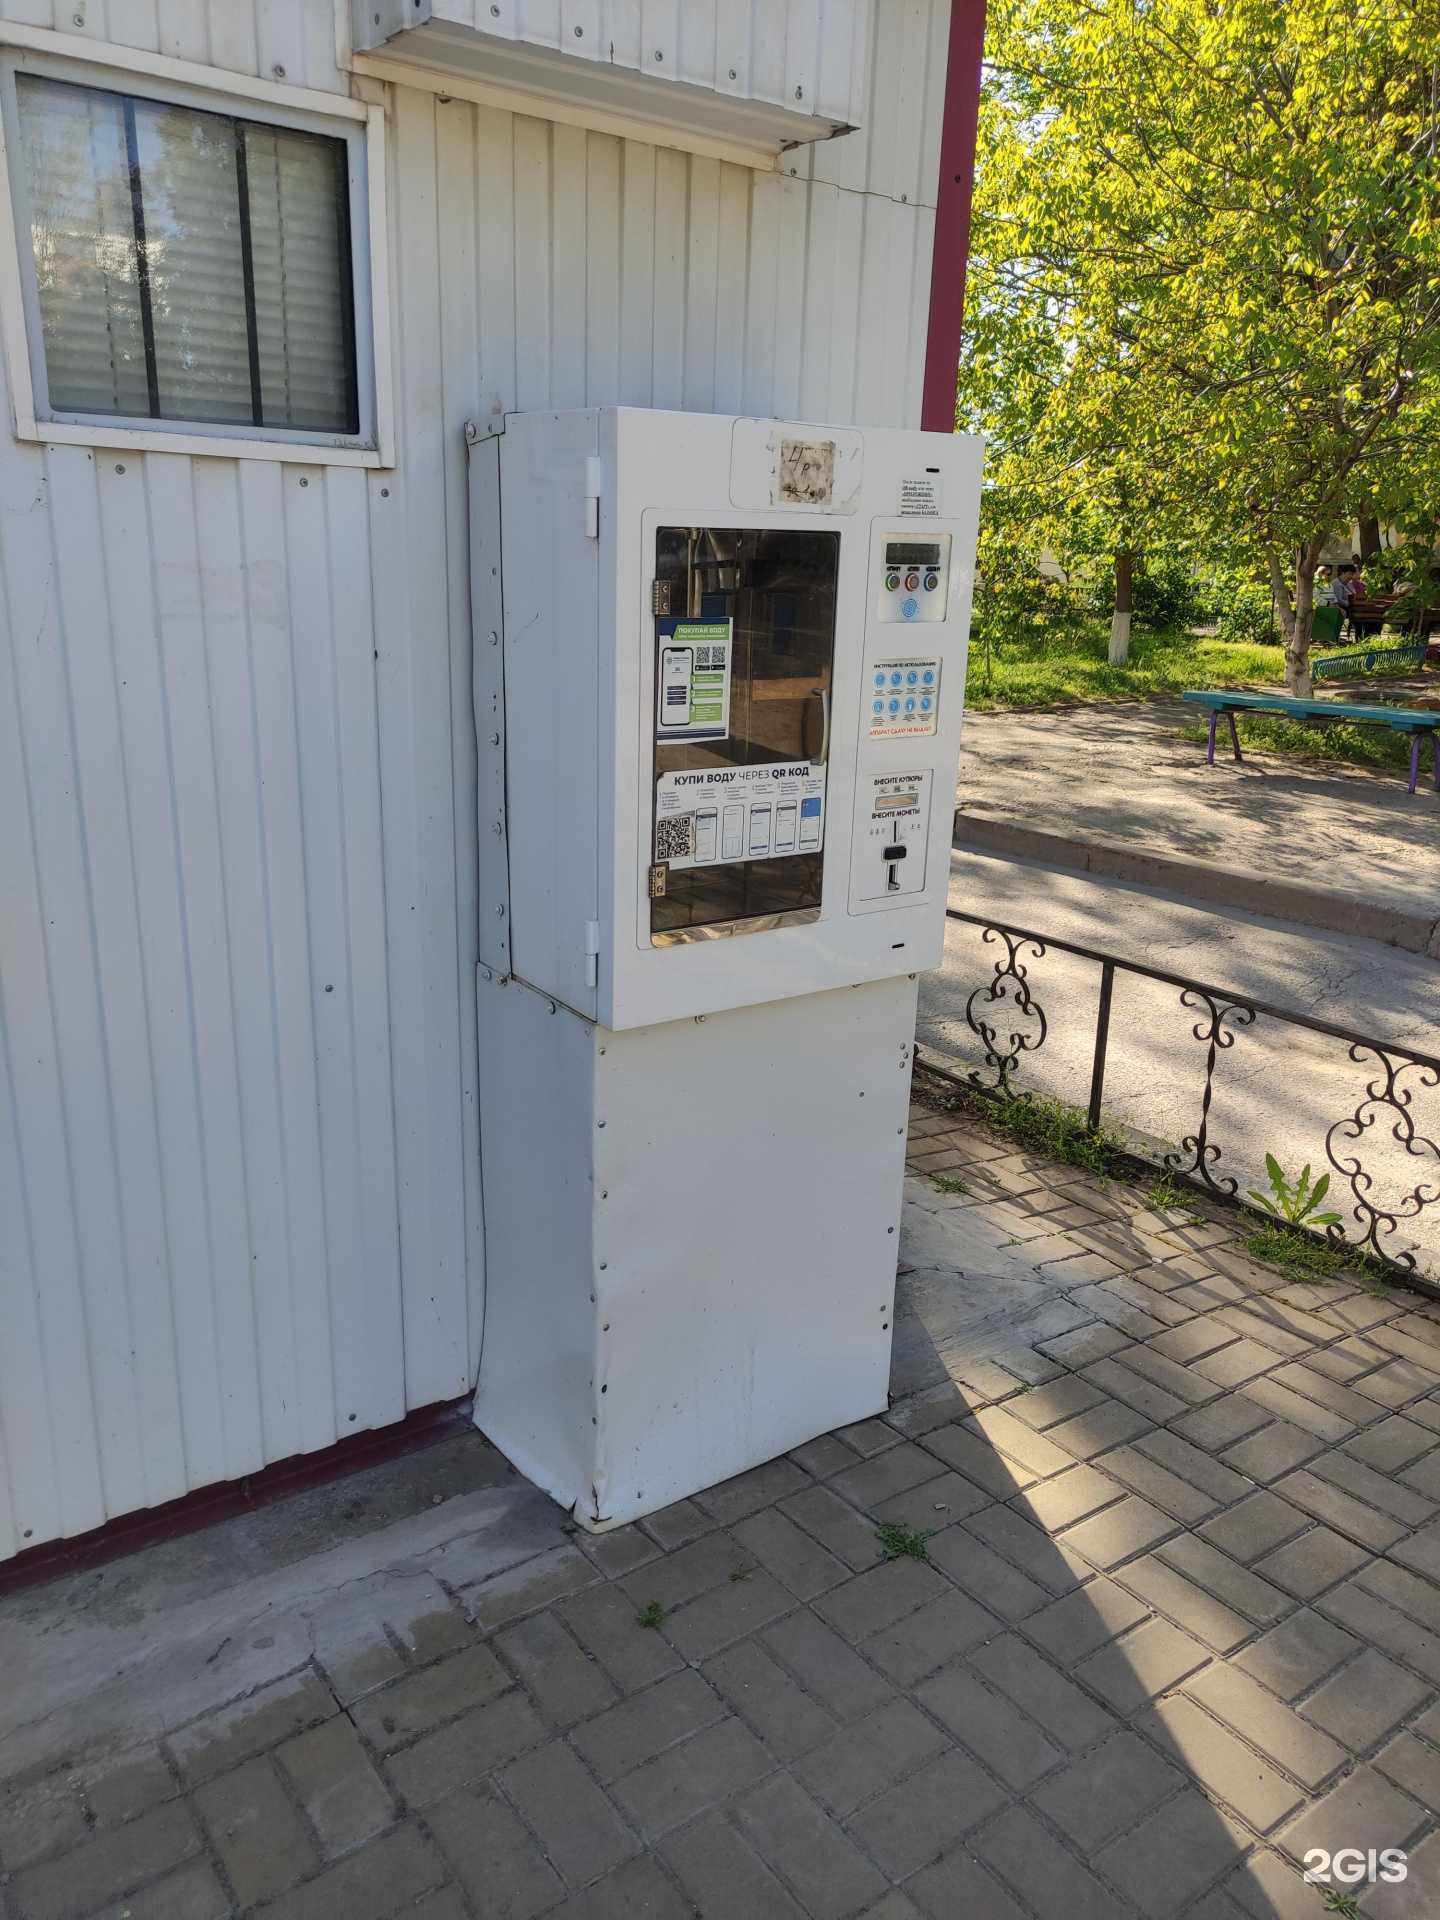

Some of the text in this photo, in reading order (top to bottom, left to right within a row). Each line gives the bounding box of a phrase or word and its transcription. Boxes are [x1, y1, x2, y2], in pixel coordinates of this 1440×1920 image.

[674, 767, 809, 786] КУПИ ВОДУ ЧЕРЕЗ QR КОД
[874, 775, 923, 785] ВНЕСИТЕ КУПЮРЫ
[871, 808, 920, 819] ВНЕСИТЕ МОНЕТЫ
